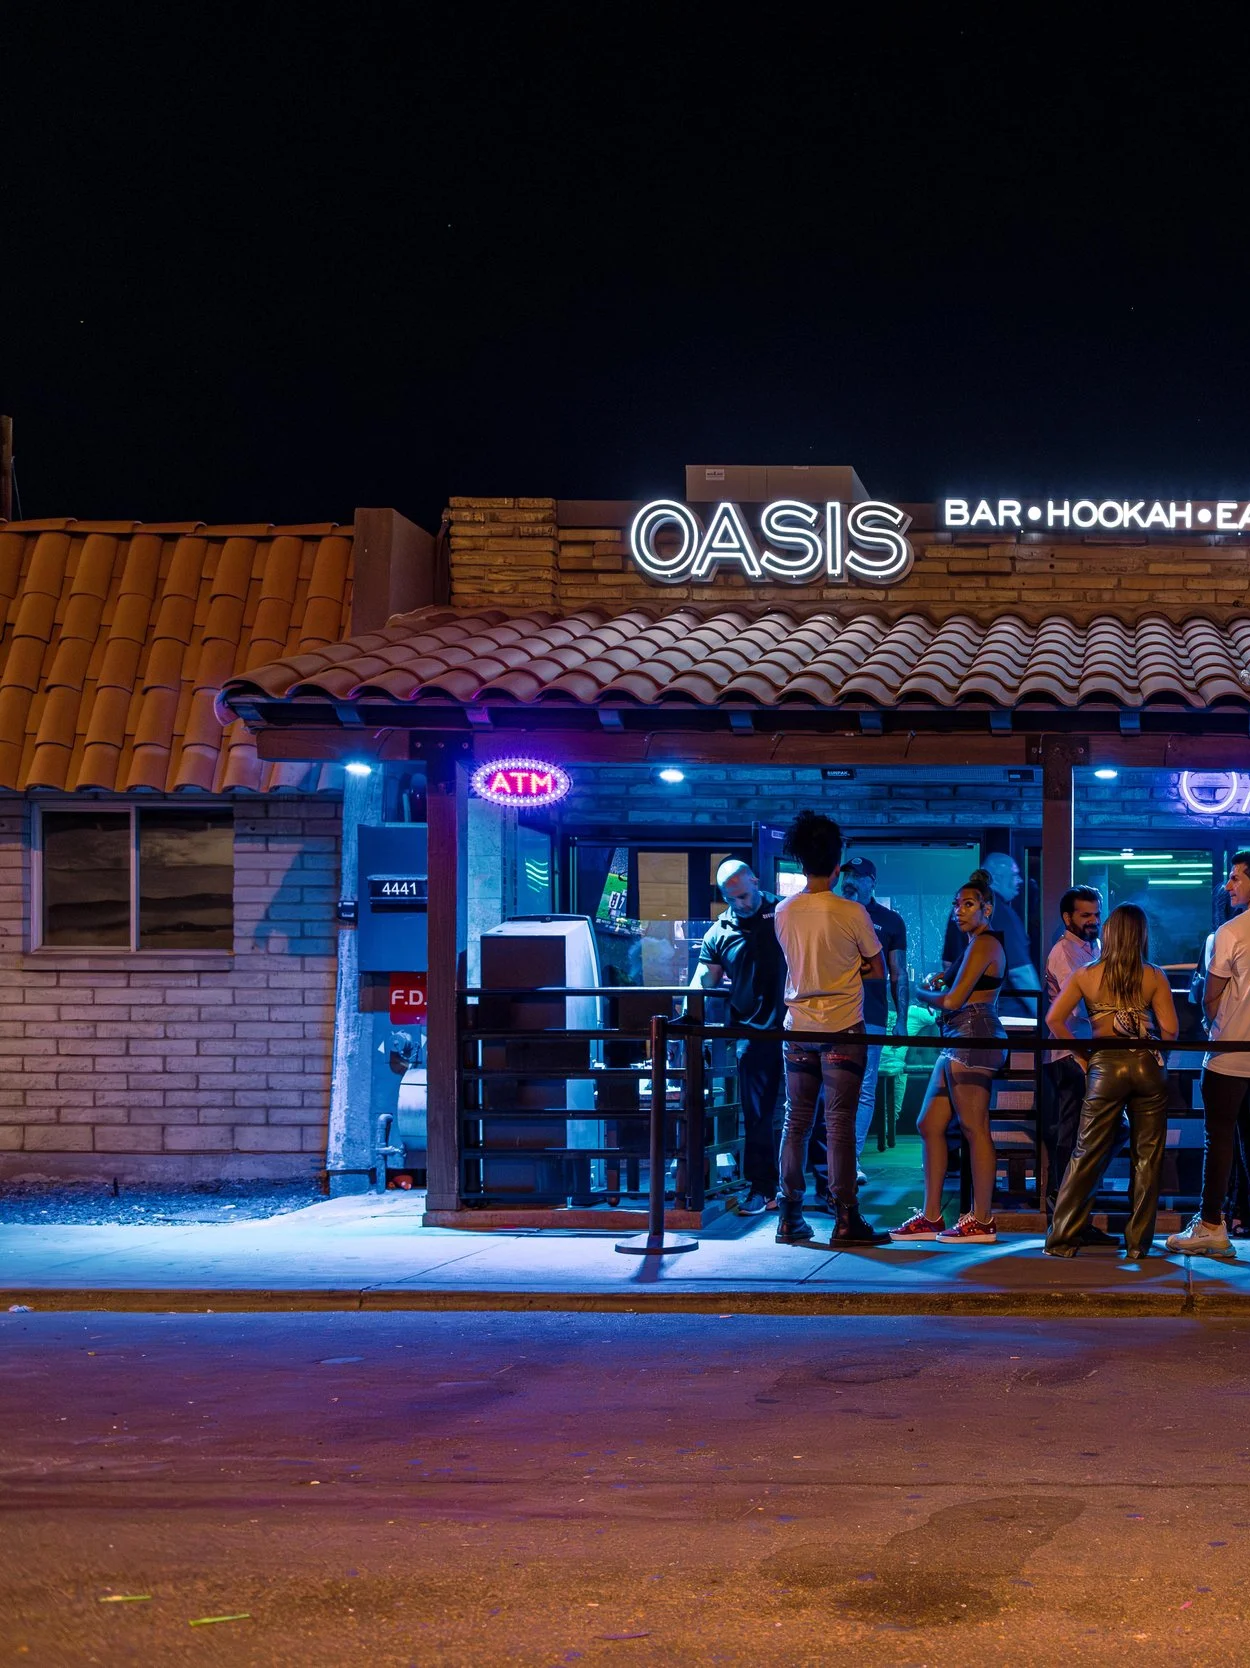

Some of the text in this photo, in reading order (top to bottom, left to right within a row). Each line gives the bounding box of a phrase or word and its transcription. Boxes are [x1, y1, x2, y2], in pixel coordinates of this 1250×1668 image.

[944, 499, 1022, 527] BAR
[1047, 500, 1192, 529] HOOKAH
[631, 500, 908, 577] OASIS
[490, 772, 553, 794] ATM
[382, 882, 417, 895] 4441
